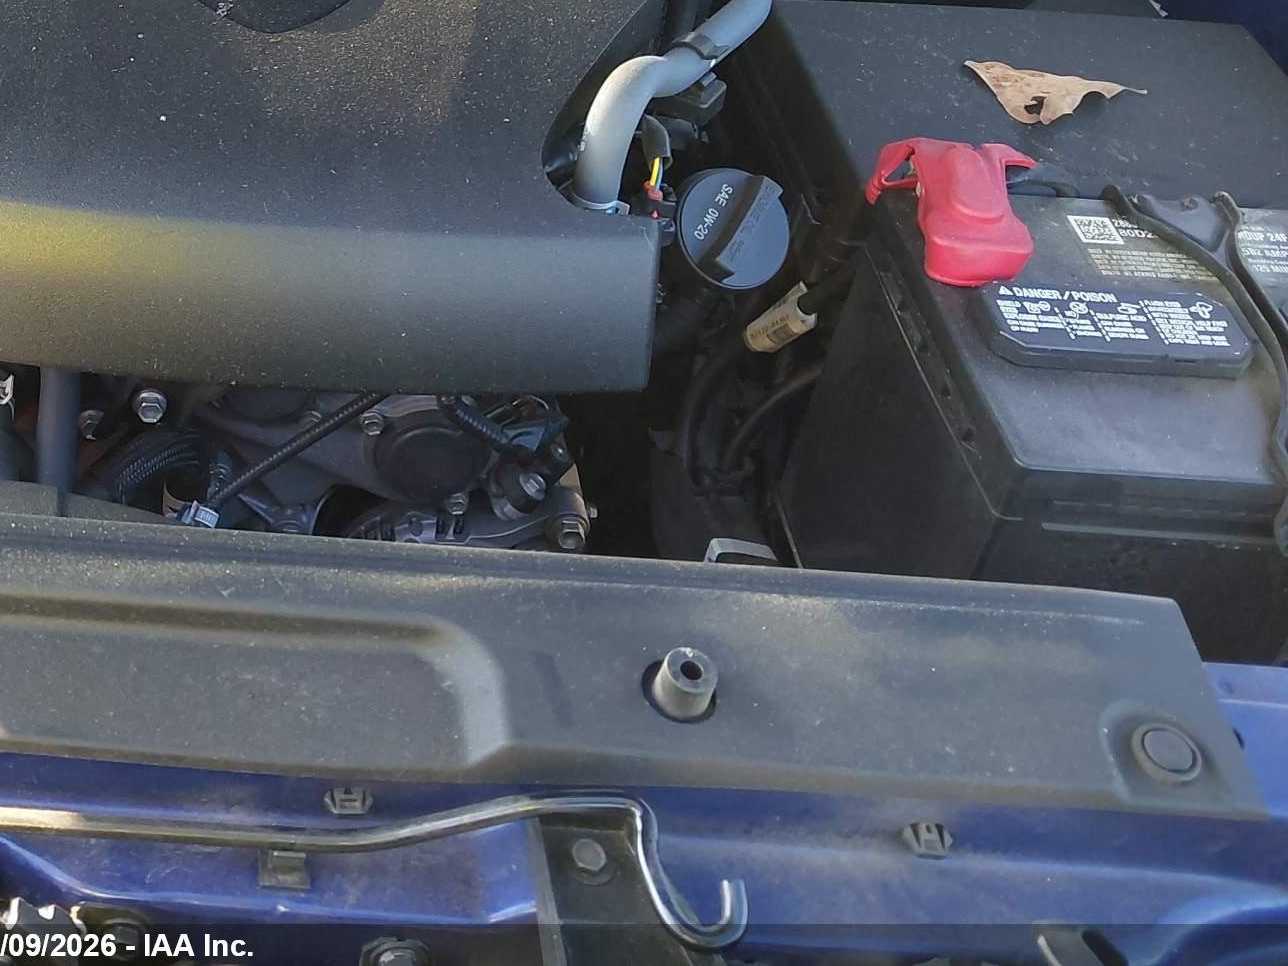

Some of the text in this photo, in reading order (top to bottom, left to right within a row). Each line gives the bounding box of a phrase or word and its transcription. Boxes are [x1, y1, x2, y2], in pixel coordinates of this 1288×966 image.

[693, 183, 734, 241] SAE 0W-20
[1012, 286, 1063, 300] DANGER
[1071, 290, 1119, 304] POISON
